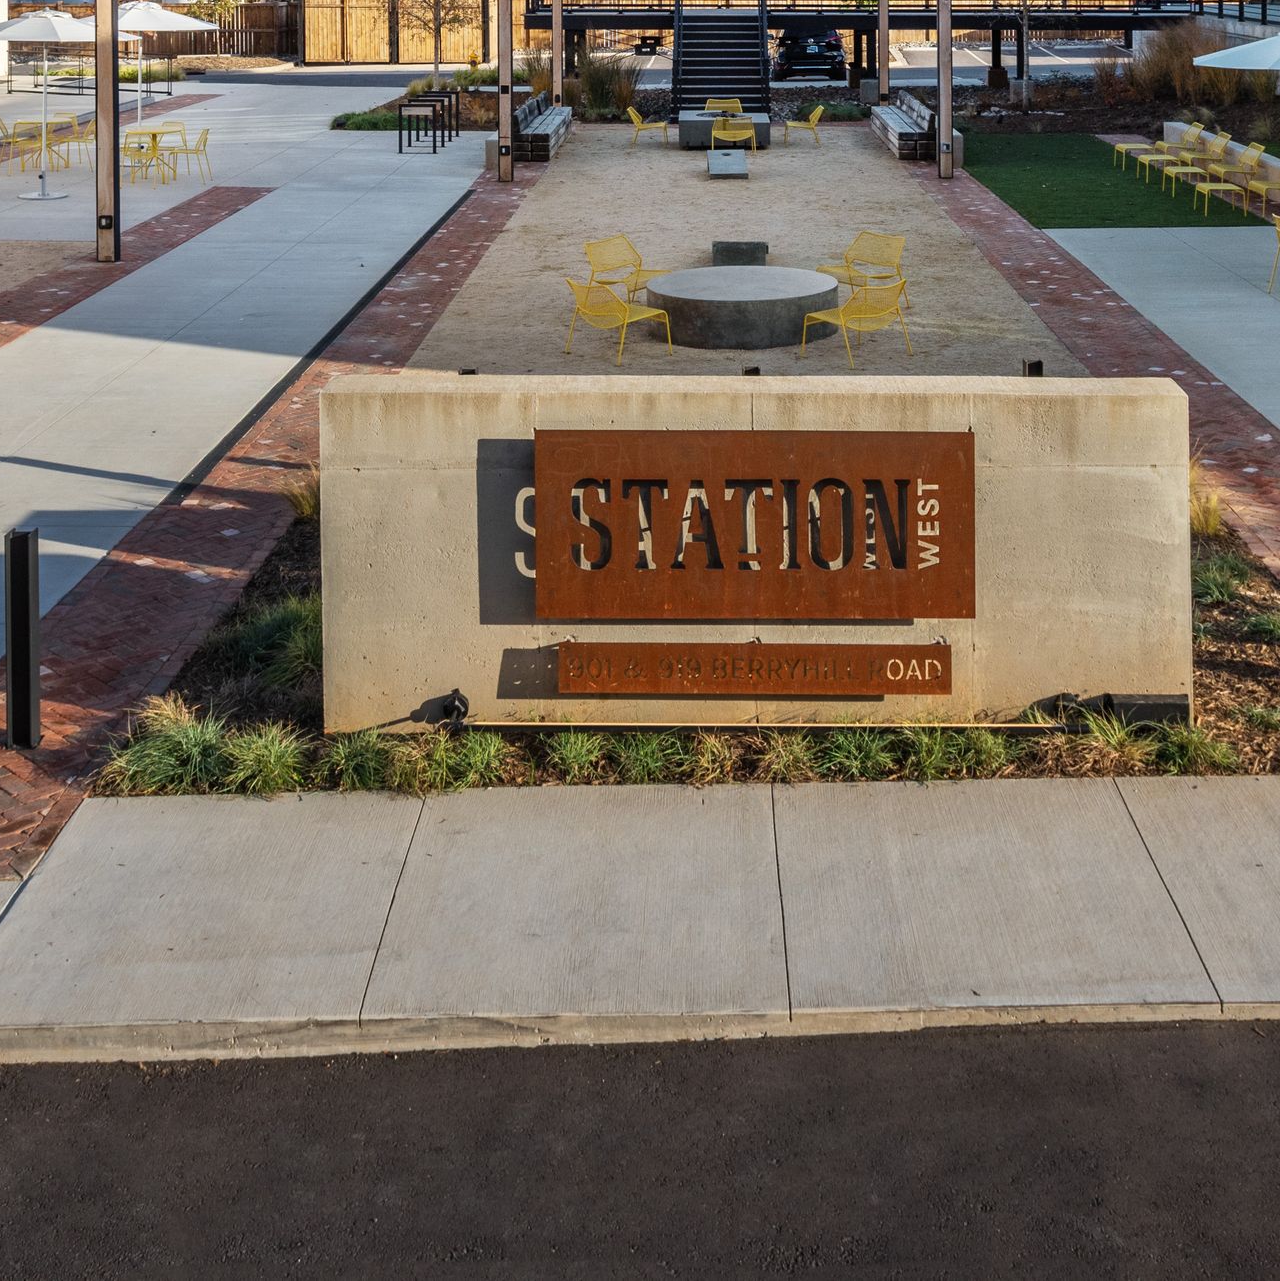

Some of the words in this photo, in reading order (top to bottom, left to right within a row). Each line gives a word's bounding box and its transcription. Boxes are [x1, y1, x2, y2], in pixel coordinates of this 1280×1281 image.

[570, 477, 911, 571] STATION
[917, 478, 940, 570] WEST
[568, 657, 612, 680] 901
[623, 657, 648, 680] &
[659, 657, 703, 680] 919
[712, 657, 859, 681] BERRYHILL
[870, 658, 942, 681] ROAD
